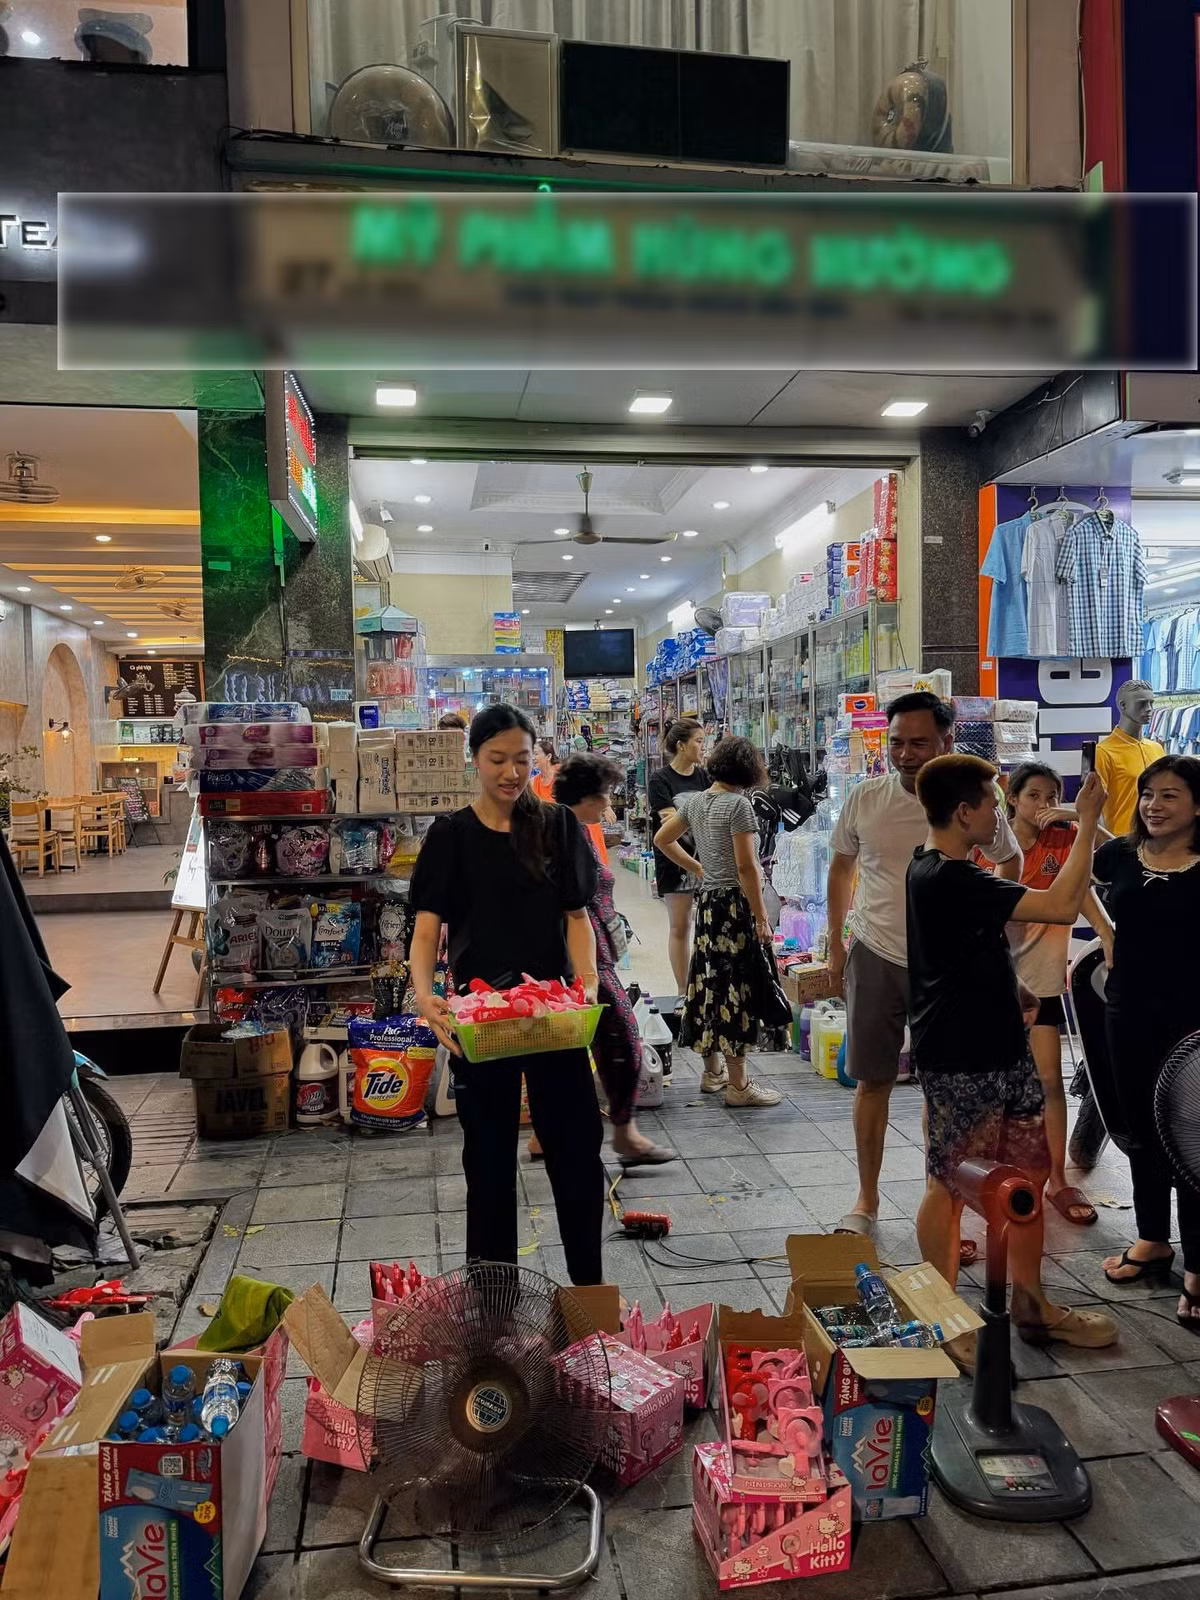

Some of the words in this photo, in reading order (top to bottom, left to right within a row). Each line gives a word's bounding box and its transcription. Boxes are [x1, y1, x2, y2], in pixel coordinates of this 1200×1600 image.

[0, 213, 58, 250] TE
[265, 926, 301, 938] Downy
[369, 1034, 413, 1043] Professional
[363, 1072, 403, 1099] Tide
[637, 1402, 658, 1421] Hello
[657, 1386, 677, 1407] Kitty
[325, 1416, 357, 1436] Hello
[324, 1432, 357, 1452] Kitty
[809, 1538, 846, 1555] Hello
[809, 1550, 846, 1570] Kitty
